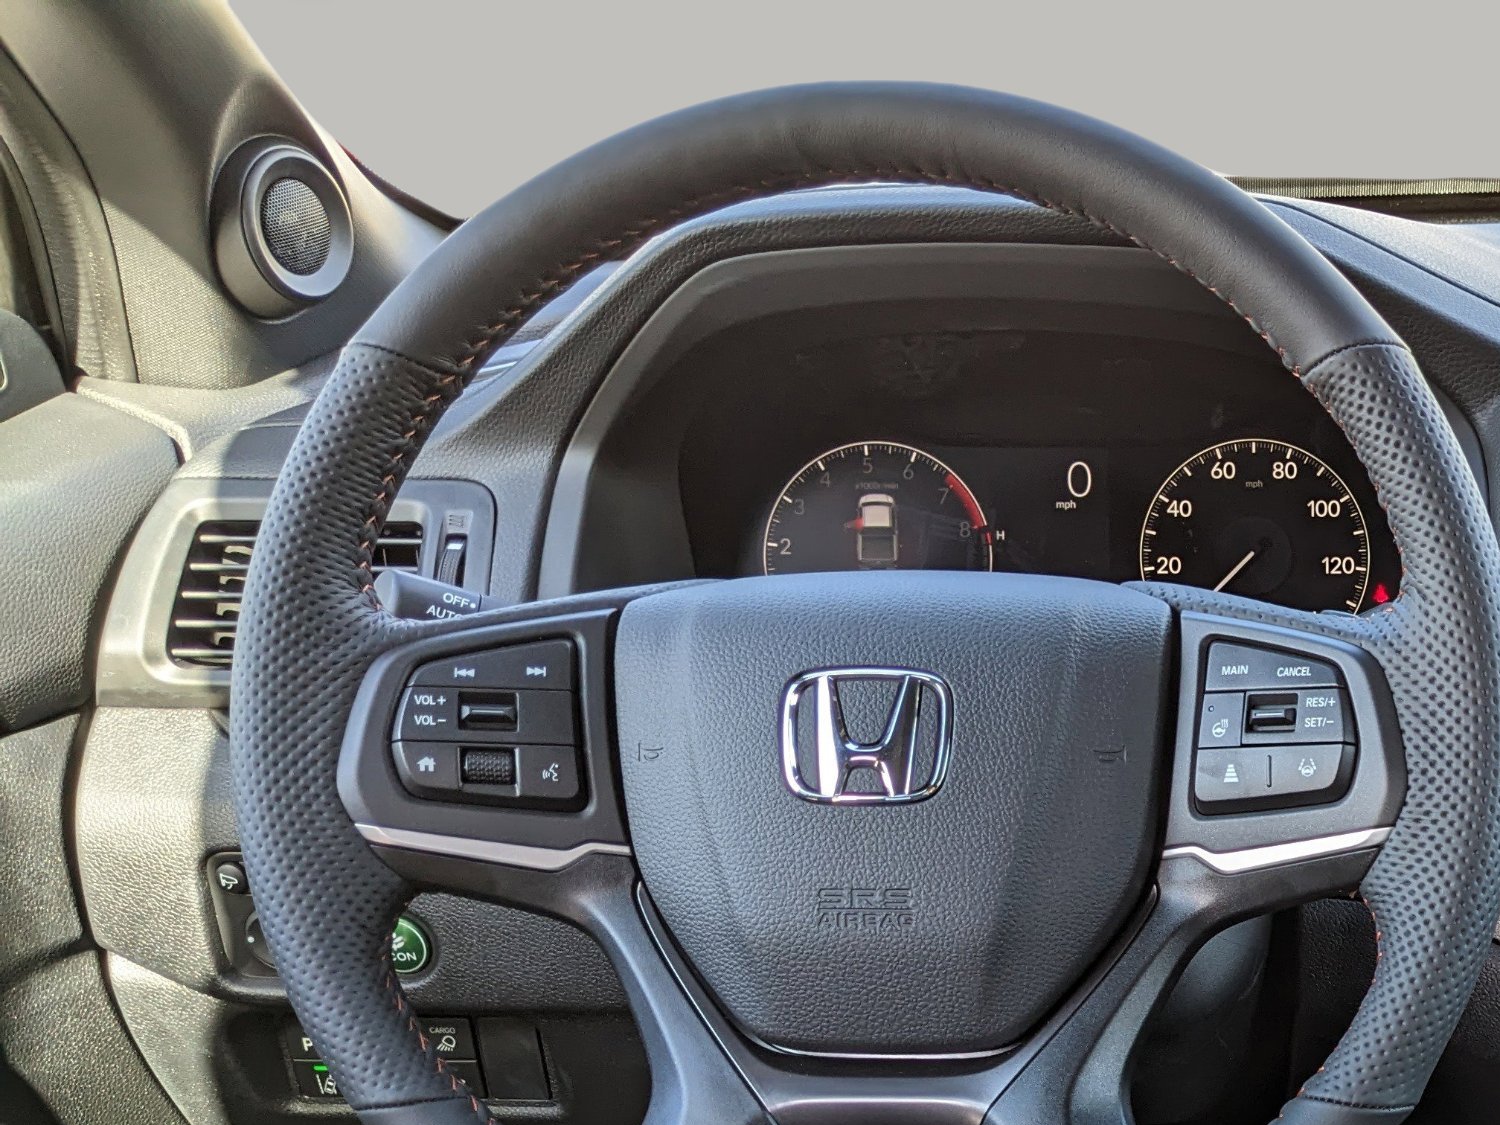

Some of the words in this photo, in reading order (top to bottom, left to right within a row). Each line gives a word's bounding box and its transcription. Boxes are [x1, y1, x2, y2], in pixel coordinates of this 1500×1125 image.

[863, 458, 873, 474] 5
[903, 464, 914, 480] 6
[1211, 462, 1236, 480] 60
[1272, 462, 1297, 480] 80
[819, 473, 830, 487] 4
[1067, 461, 1092, 498] 0
[1245, 480, 1263, 490] mph
[938, 488, 949, 504] 7
[795, 501, 805, 516] 3
[1056, 500, 1076, 511] mph
[1167, 500, 1192, 518] 40
[1307, 500, 1341, 518] 100
[959, 522, 970, 538] 8
[780, 538, 792, 555] 2
[1156, 557, 1182, 575] 20
[1321, 557, 1355, 575] 120
[443, 592, 470, 608] OFF
[1221, 665, 1249, 676] MAIN
[1277, 666, 1312, 677] CANCEL
[1306, 697, 1336, 708] RES/+
[818, 888, 911, 906] SRS
[818, 912, 914, 927] AIRBAG
[429, 1026, 457, 1035] CARGO
